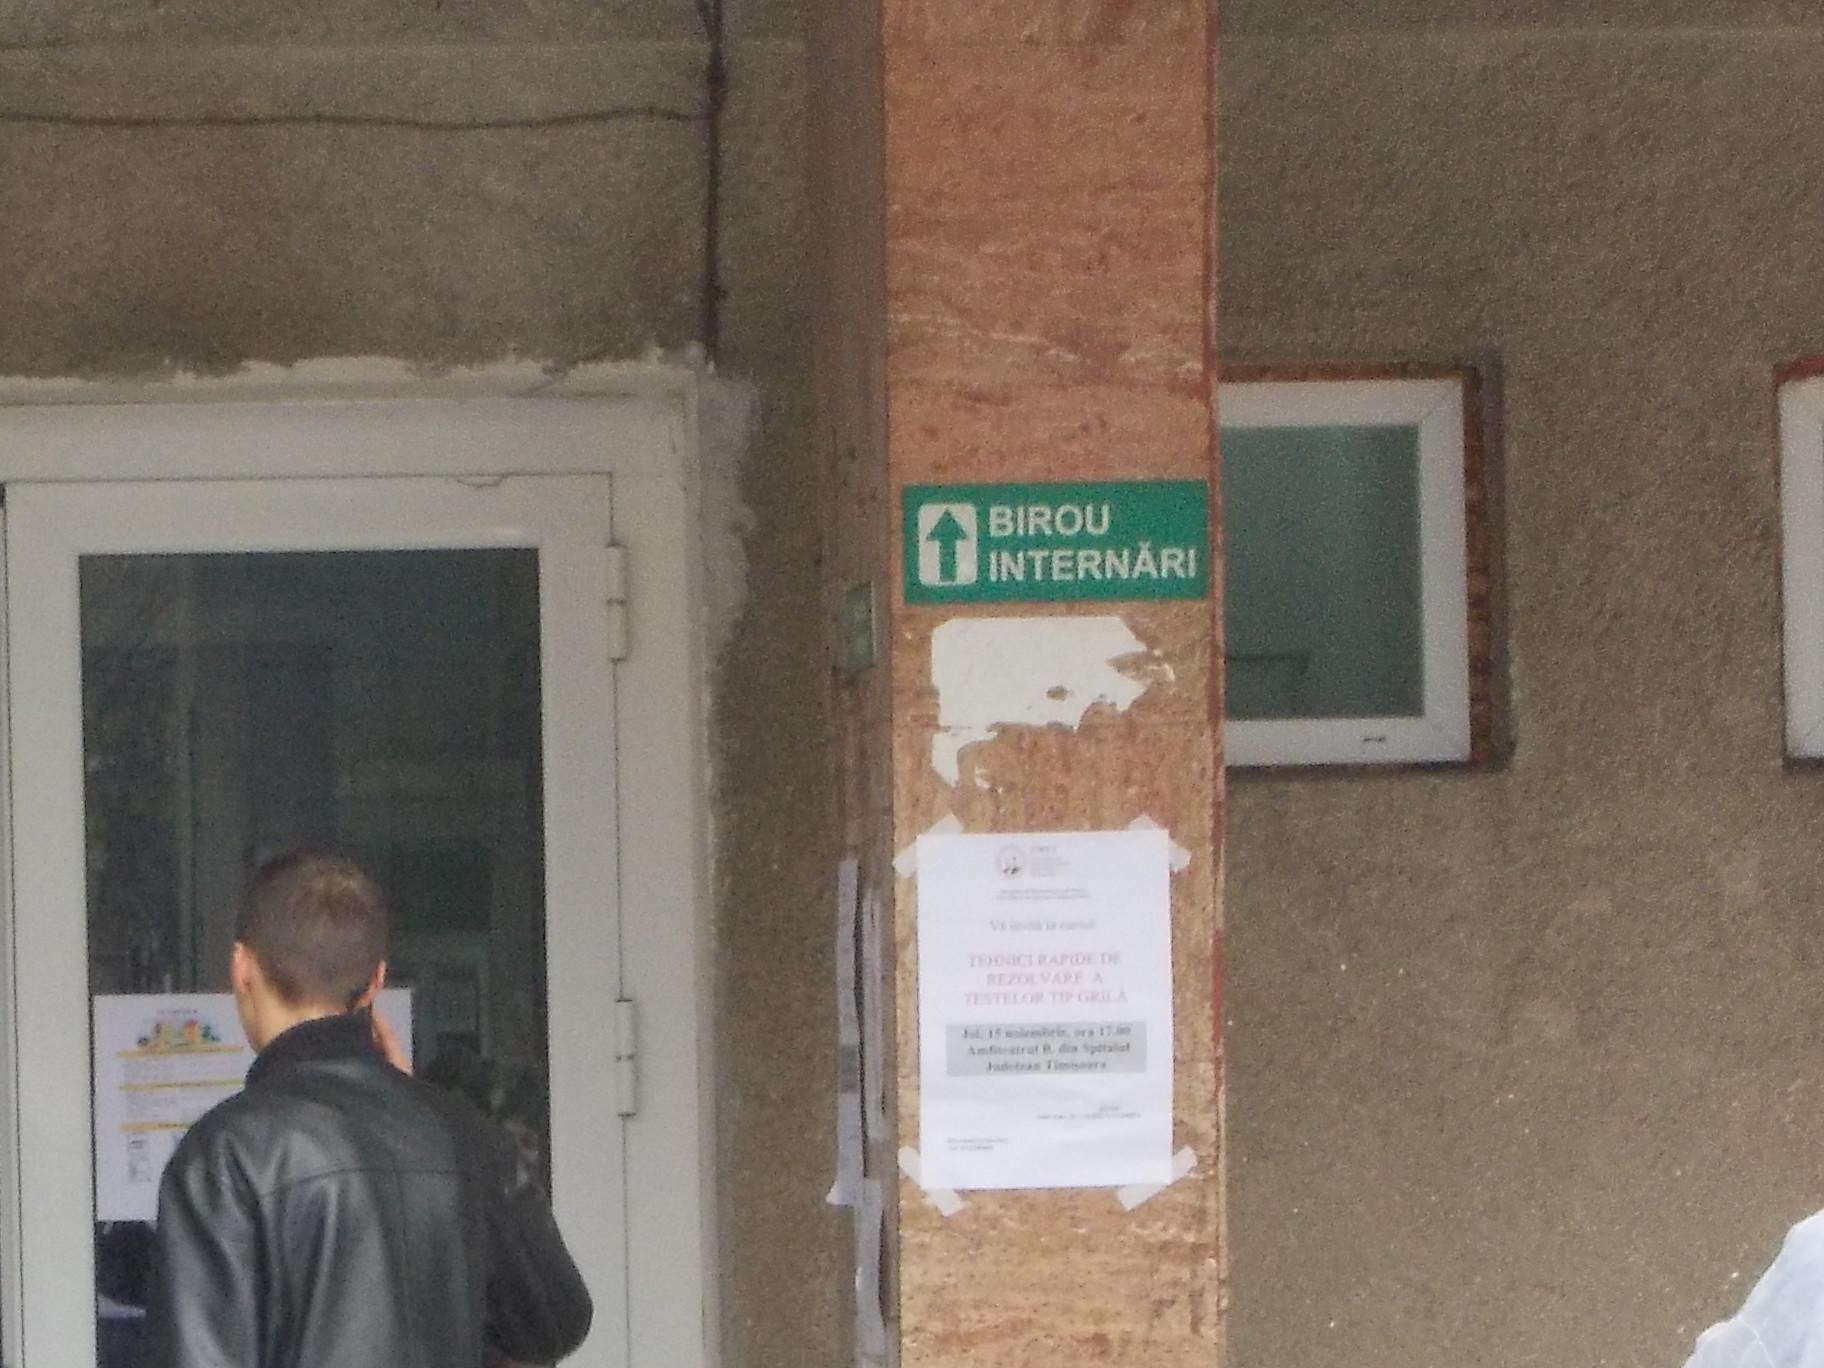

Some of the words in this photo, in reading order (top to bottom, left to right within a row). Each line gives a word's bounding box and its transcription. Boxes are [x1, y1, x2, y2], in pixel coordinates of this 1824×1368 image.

[987, 503, 1111, 537] BIROU
[988, 540, 1197, 582] INTERNĂRI
[1037, 952, 1097, 967] RAPIDE
[1101, 951, 1122, 965] DE
[986, 971, 1084, 986] REZOLVARE
